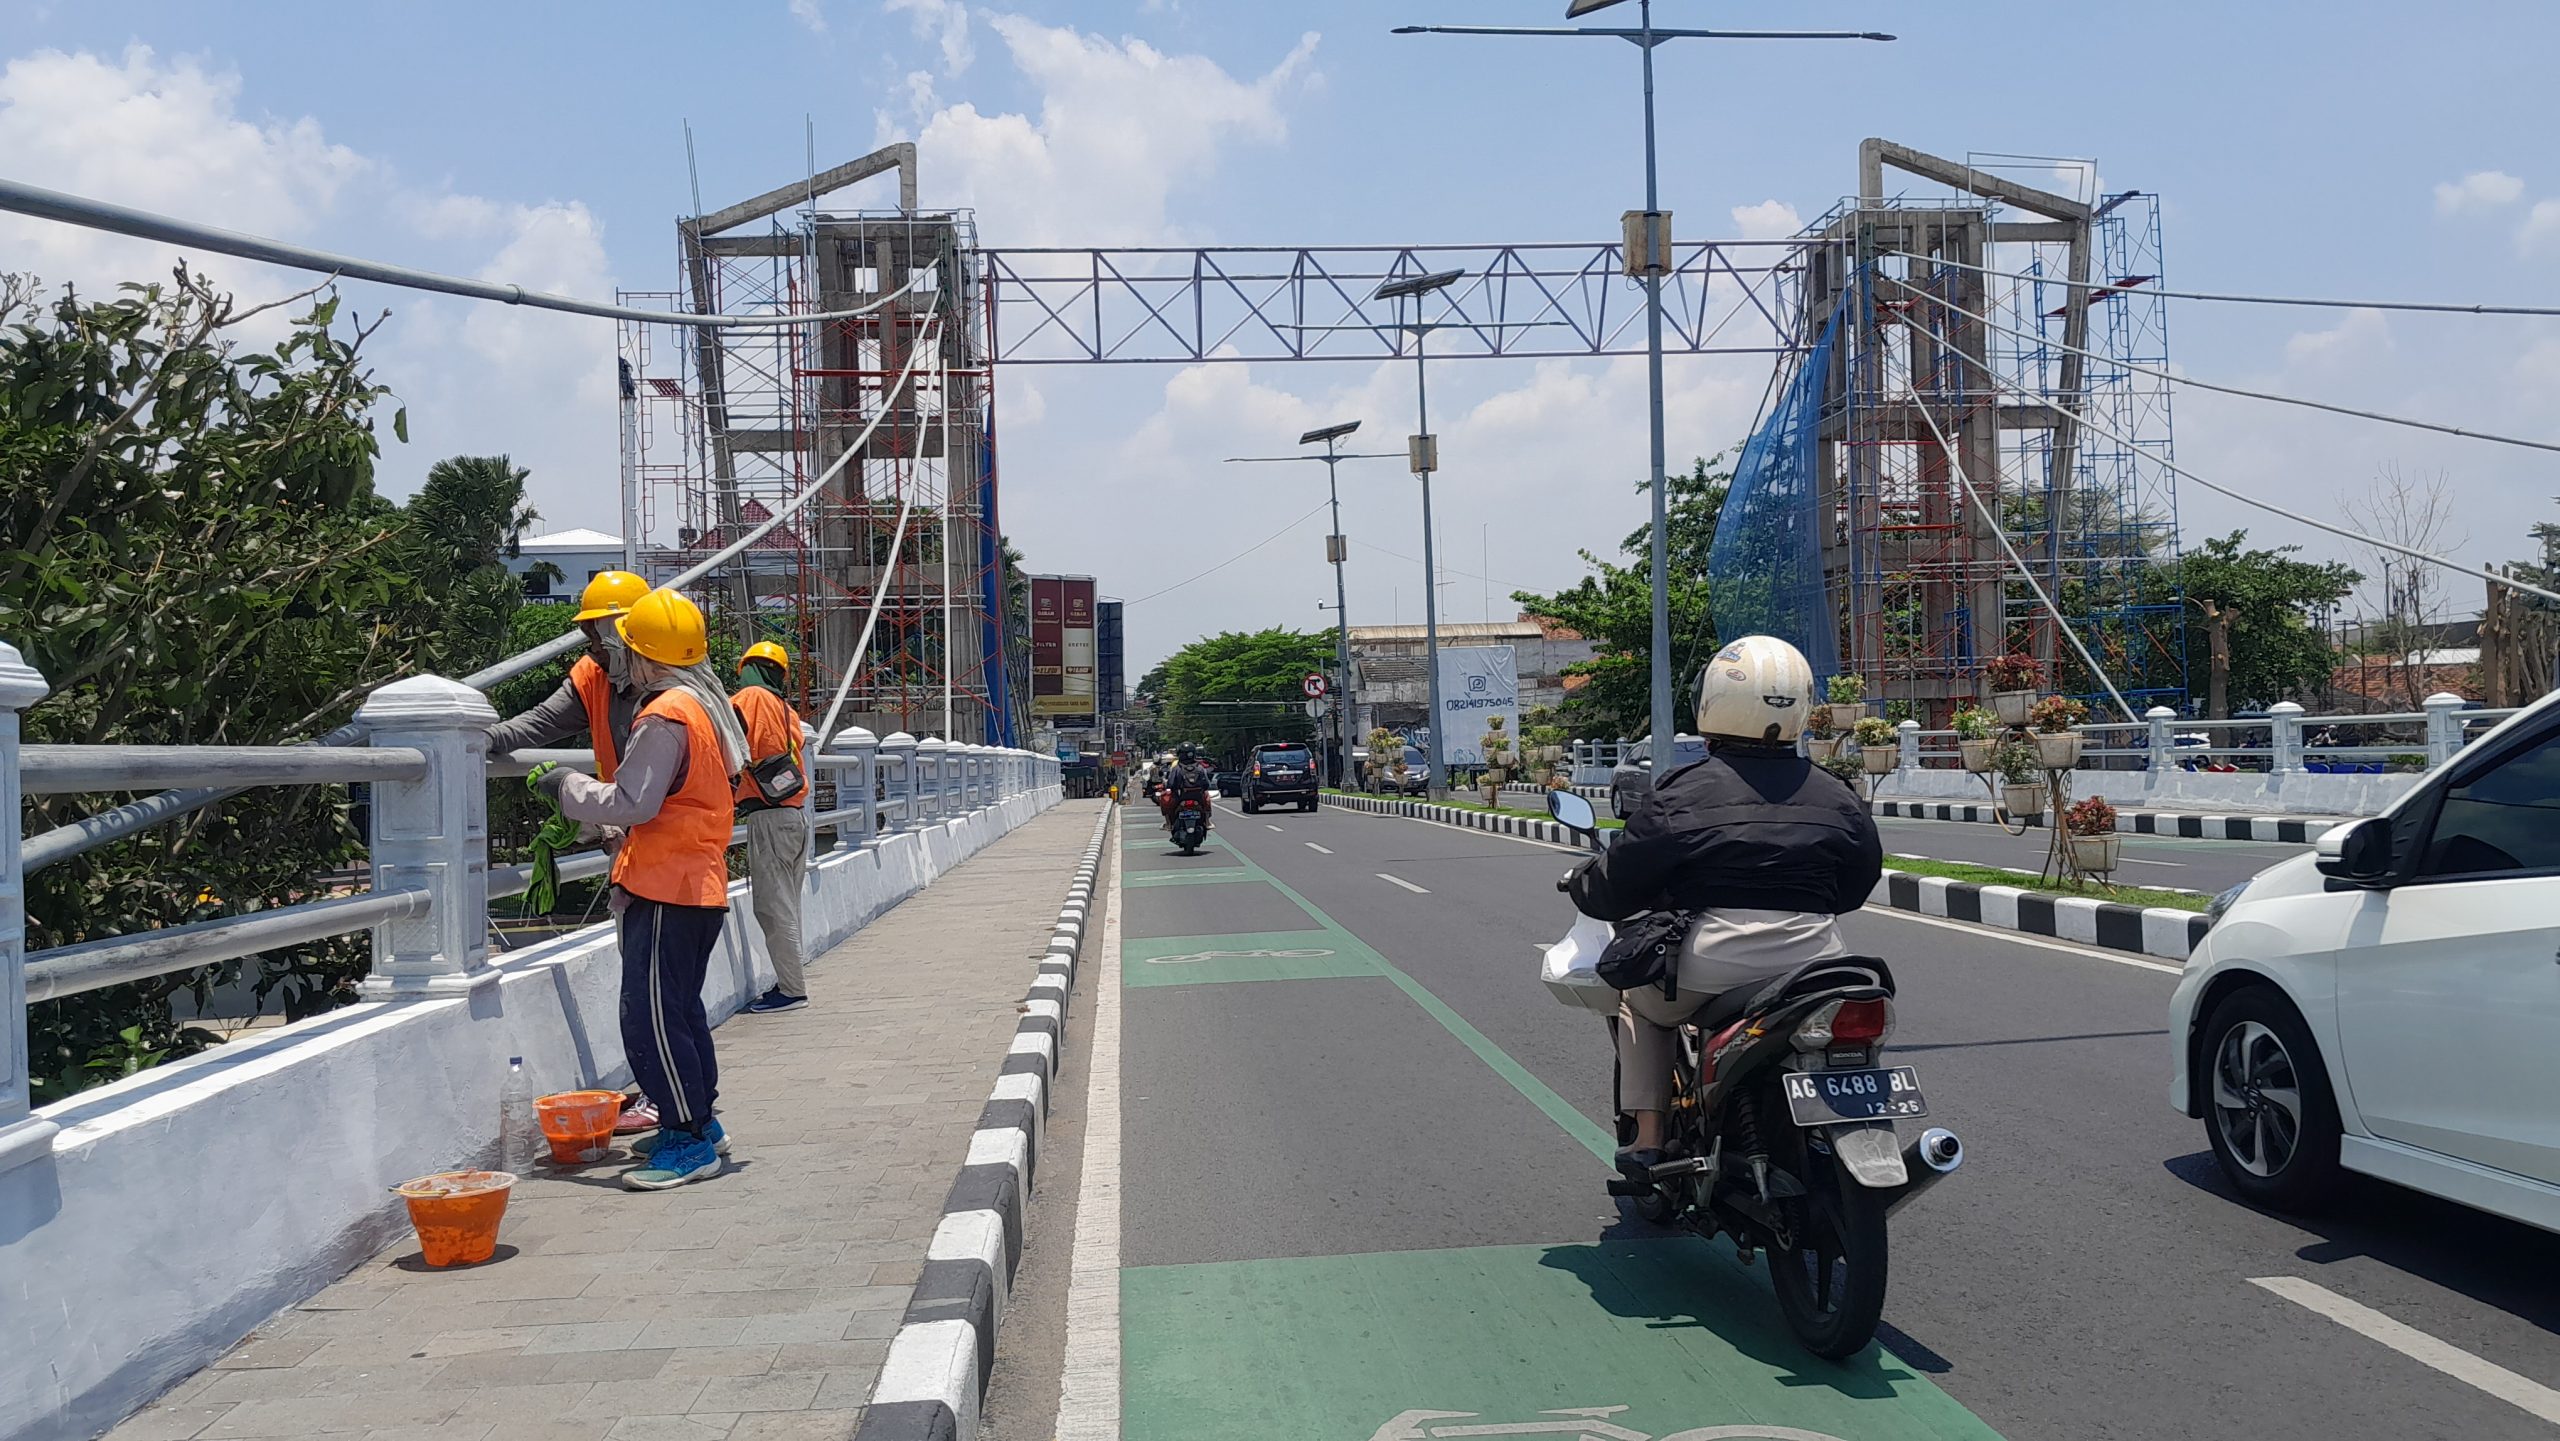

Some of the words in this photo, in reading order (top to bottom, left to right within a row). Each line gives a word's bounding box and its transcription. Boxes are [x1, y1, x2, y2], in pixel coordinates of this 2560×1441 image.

[1446, 697, 1515, 711] 082141975045
[1791, 1078, 1818, 1099] AG
[1826, 1074, 1878, 1096] 6488
[1888, 1071, 1916, 1092] BL
